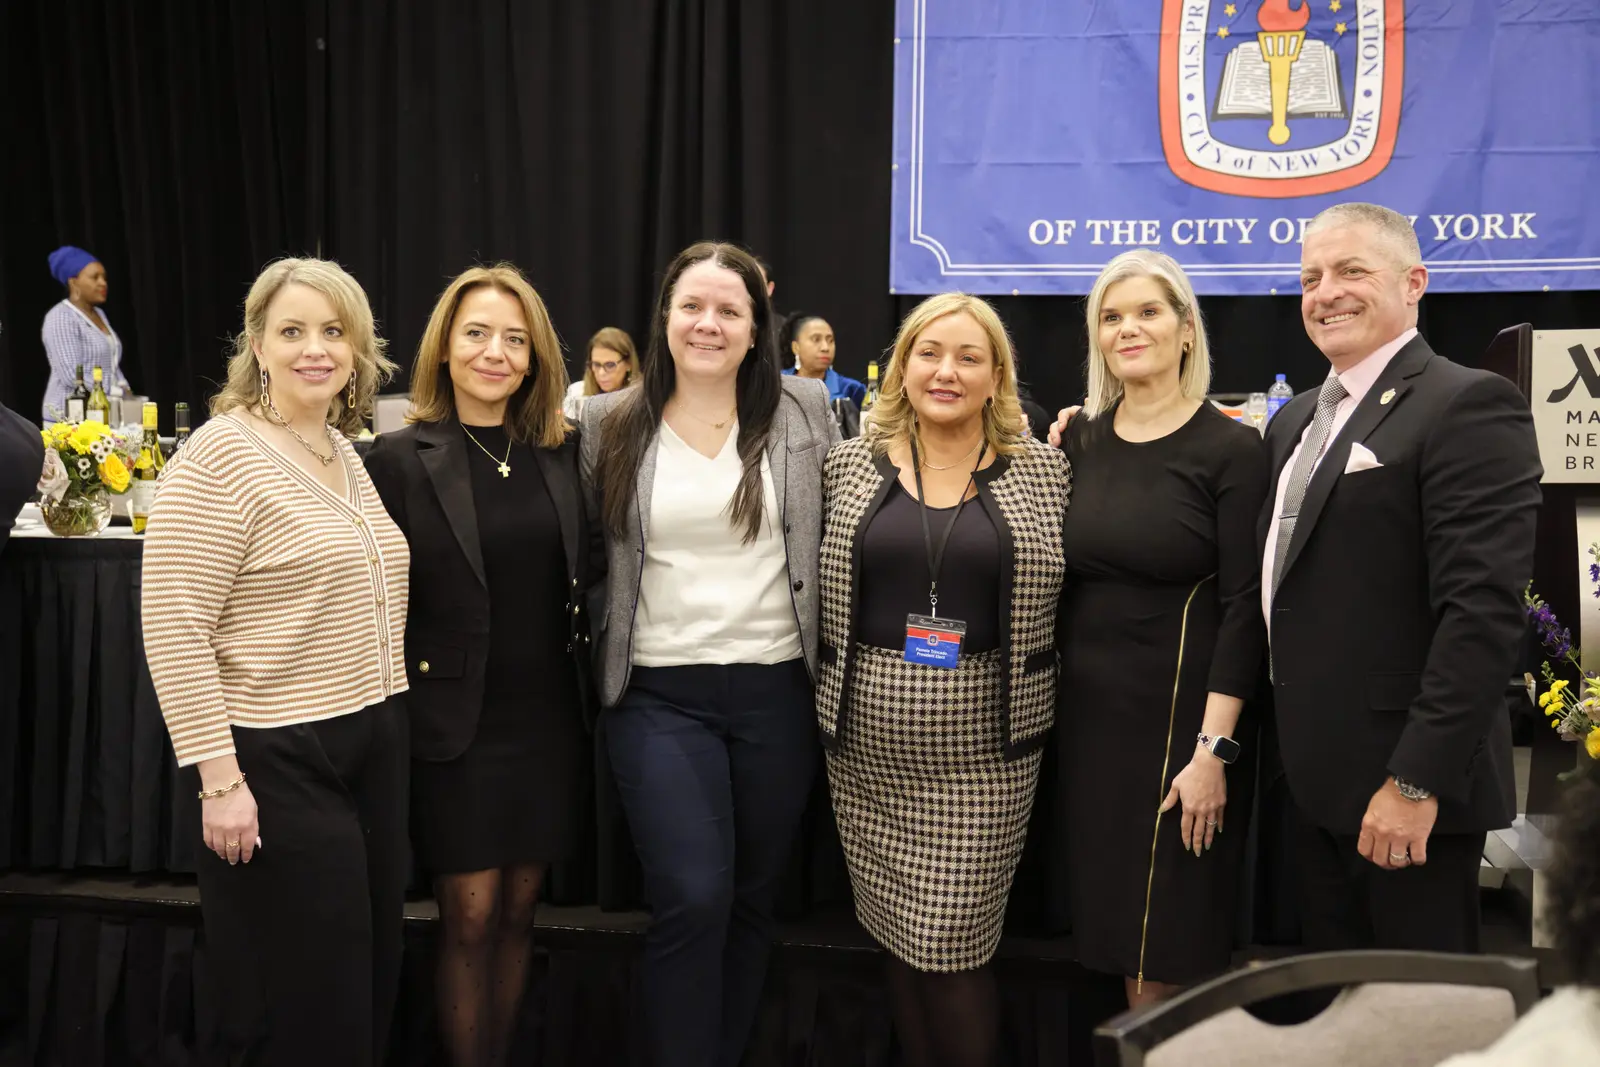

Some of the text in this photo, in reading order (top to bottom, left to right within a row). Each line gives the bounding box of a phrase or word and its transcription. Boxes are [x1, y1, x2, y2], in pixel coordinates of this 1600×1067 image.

[1186, 109, 1374, 172] CITY of NEW YORK
[1028, 219, 1076, 245] OF
[1086, 219, 1161, 245] THE
[1171, 218, 1258, 245] CITY
[1429, 213, 1538, 241] YORK
